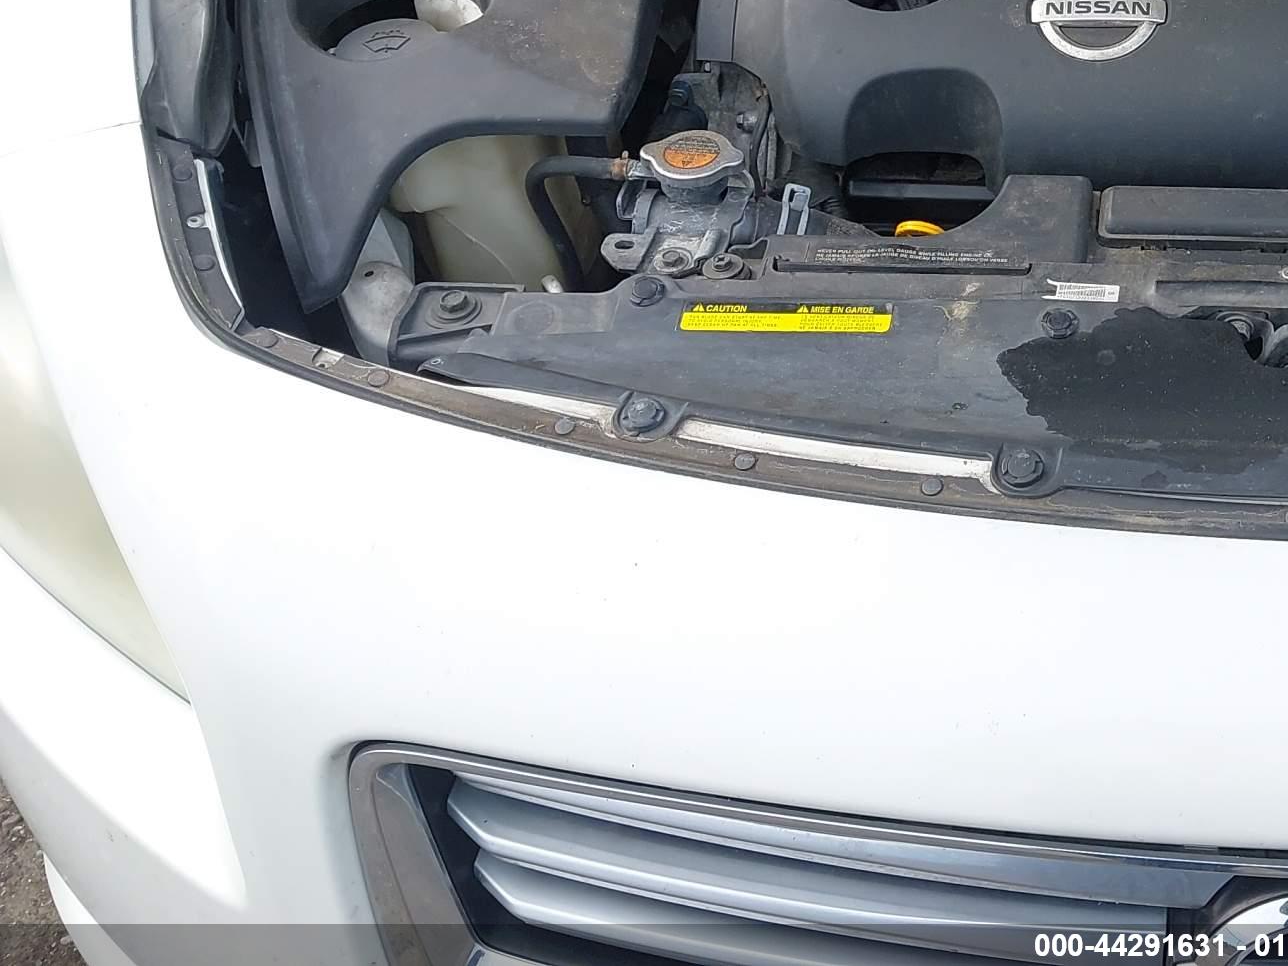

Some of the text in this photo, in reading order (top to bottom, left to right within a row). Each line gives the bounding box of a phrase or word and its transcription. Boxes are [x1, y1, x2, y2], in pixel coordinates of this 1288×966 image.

[1045, 0, 1151, 16] NISSAN
[705, 304, 748, 313] CAUTION
[810, 305, 875, 314] MISE EN GARDE
